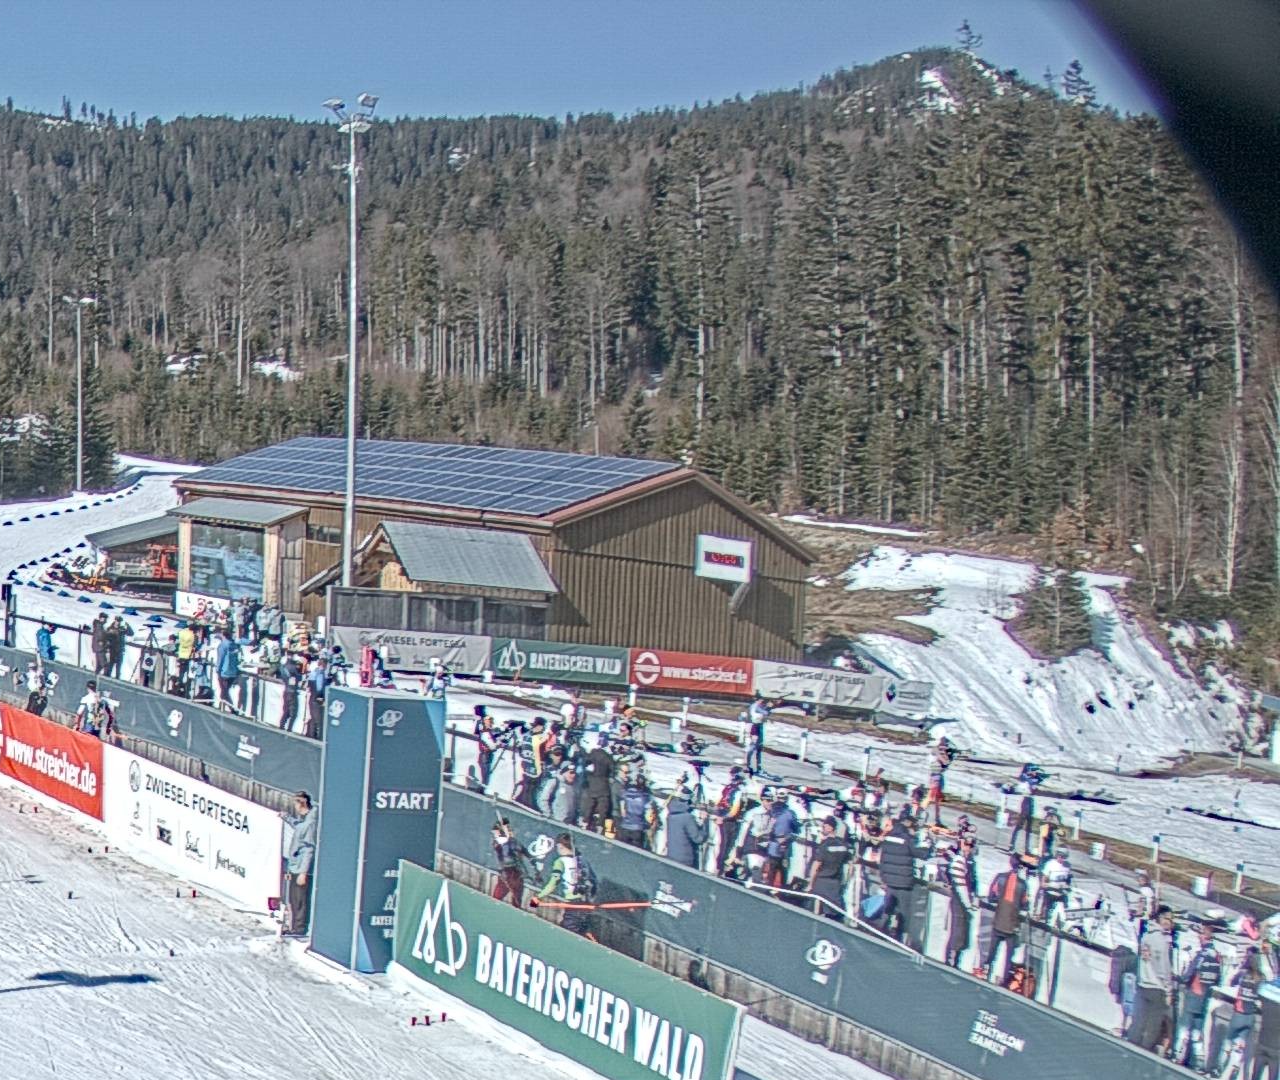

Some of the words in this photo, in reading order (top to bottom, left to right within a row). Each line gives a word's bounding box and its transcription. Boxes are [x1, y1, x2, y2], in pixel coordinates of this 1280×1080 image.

[529, 652, 594, 674] BAYERISCHER
[596, 657, 622, 676] WALD
[662, 665, 748, 685] www.streicher.de
[5, 736, 97, 797] www.streicher.de
[145, 773, 190, 808] ZWIESEL
[192, 793, 251, 835] FORTESSA
[375, 791, 434, 810] START
[474, 933, 631, 1054] BAYERISCHER
